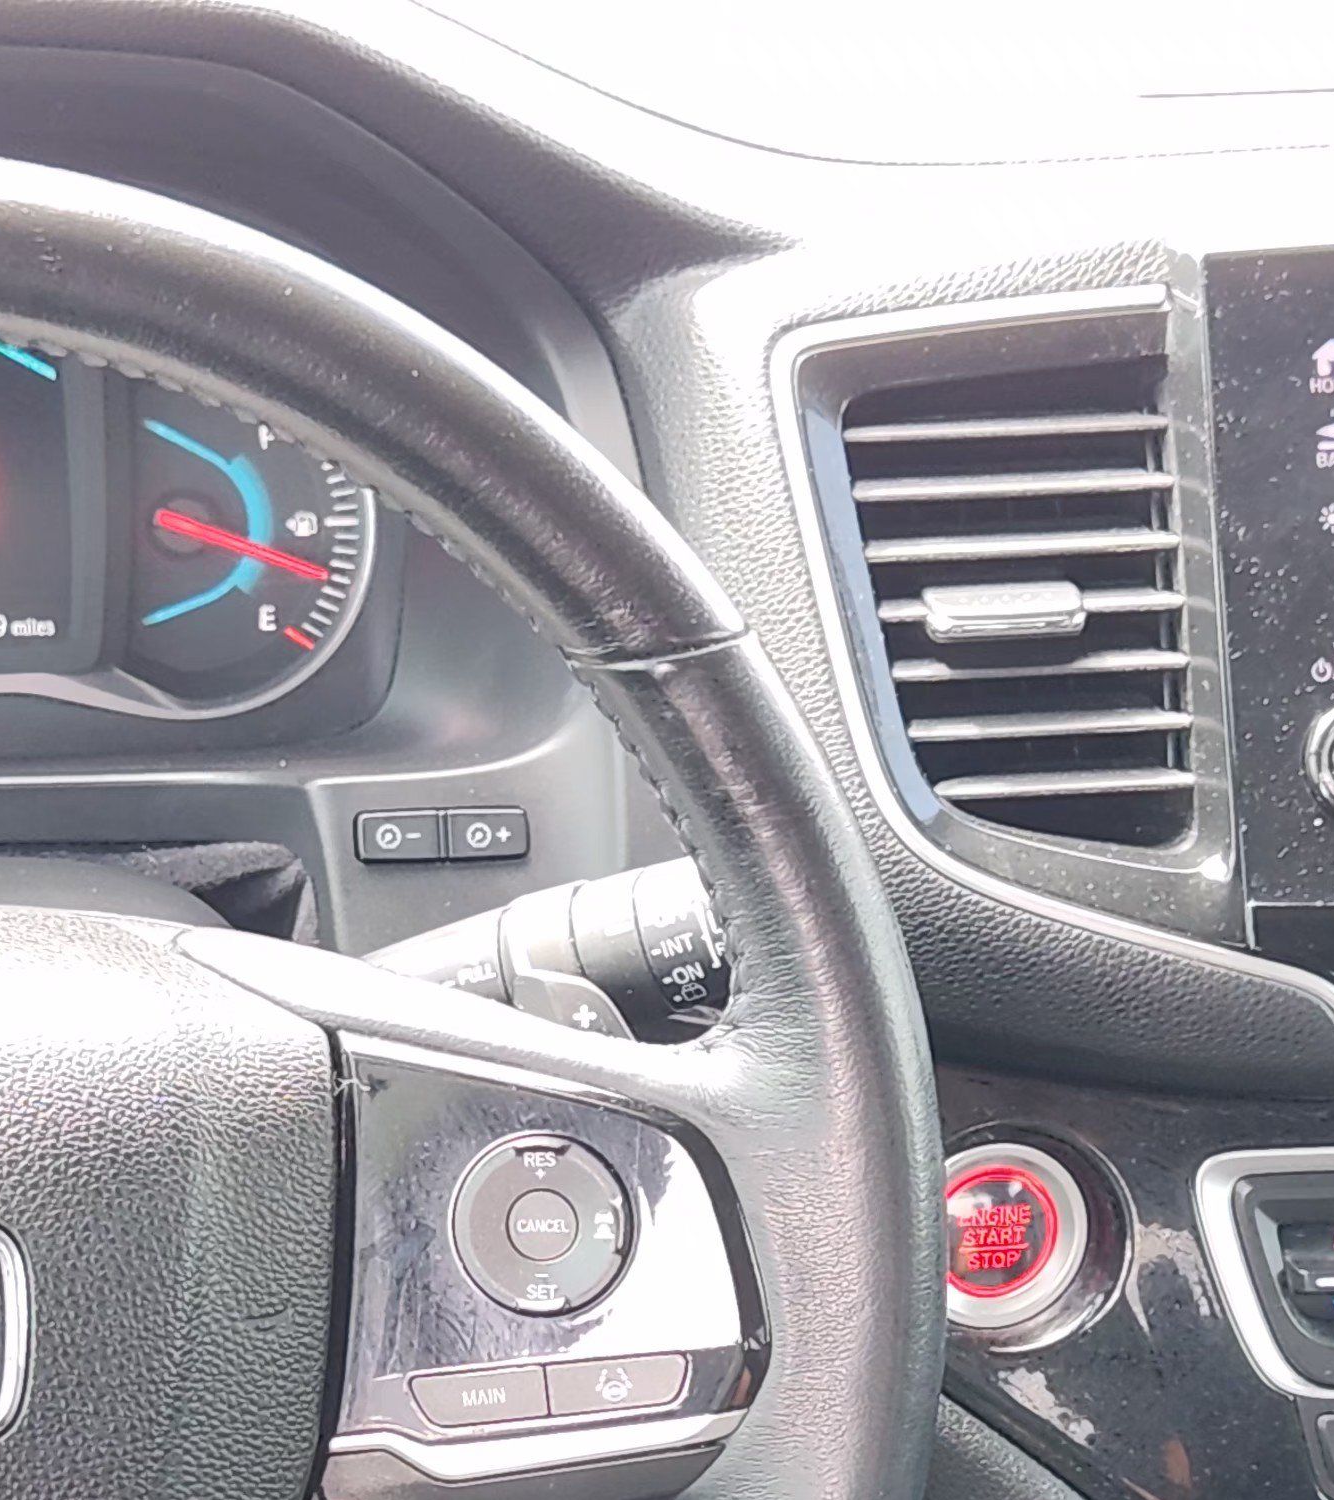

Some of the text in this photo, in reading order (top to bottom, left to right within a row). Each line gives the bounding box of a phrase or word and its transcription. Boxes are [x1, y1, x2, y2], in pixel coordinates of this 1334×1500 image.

[258, 604, 277, 632] E
[672, 961, 706, 985] ON
[523, 1150, 556, 1168] RES
[516, 1217, 569, 1234] CANCEL
[963, 1226, 1028, 1247] START
[967, 1251, 1022, 1271] STOP
[526, 1283, 557, 1301] SET
[461, 1386, 507, 1408] MAIN
